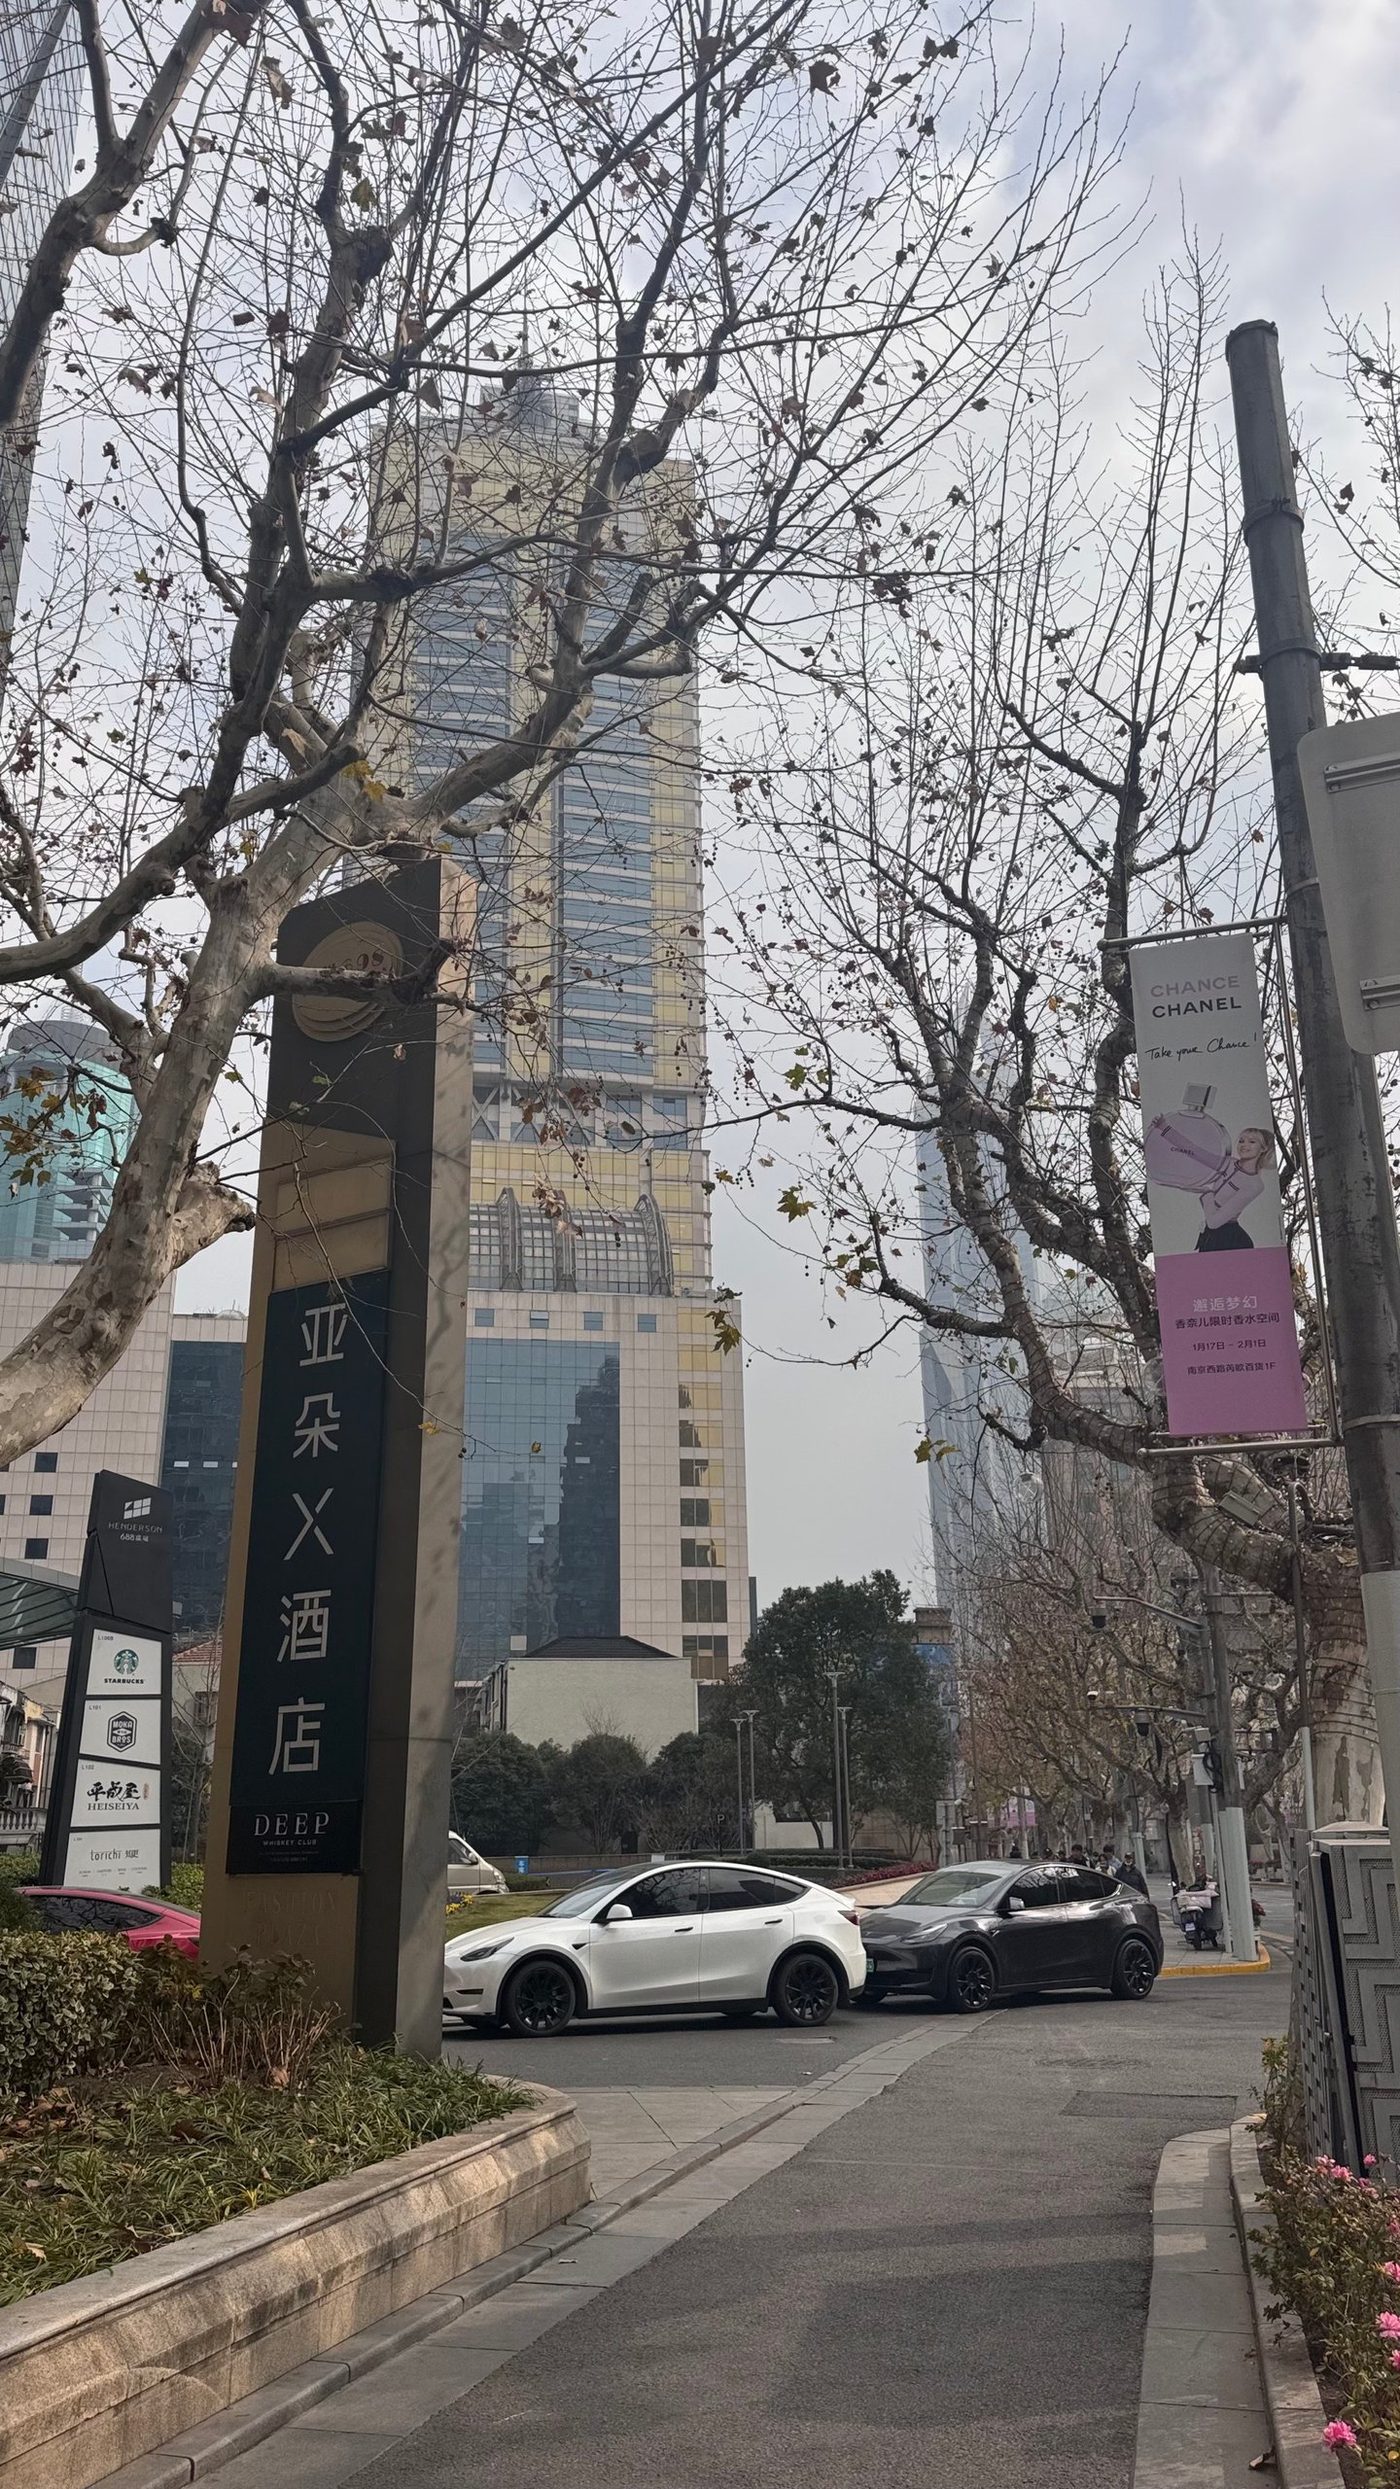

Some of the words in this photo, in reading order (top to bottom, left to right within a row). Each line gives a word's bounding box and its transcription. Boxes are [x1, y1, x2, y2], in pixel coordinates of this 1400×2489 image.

[1150, 975, 1241, 998] CHANCE
[1151, 996, 1242, 1018] CHANEL
[1145, 1046, 1173, 1060] Take
[1192, 1295, 1258, 1313] 邂逅梦幻
[1175, 1312, 1280, 1330] 香奈儿限时香水空间
[1192, 1341, 1225, 1352] 1月17日
[1237, 1339, 1267, 1349] 2月1日
[108, 1521, 163, 1534] HENDERSON
[113, 1720, 133, 1729] MOKA
[87, 1802, 140, 1811] HEISEIYA
[254, 1811, 330, 1836] DEEP
[717, 1814, 726, 1824] P
[297, 1838, 317, 1846] CLUB
